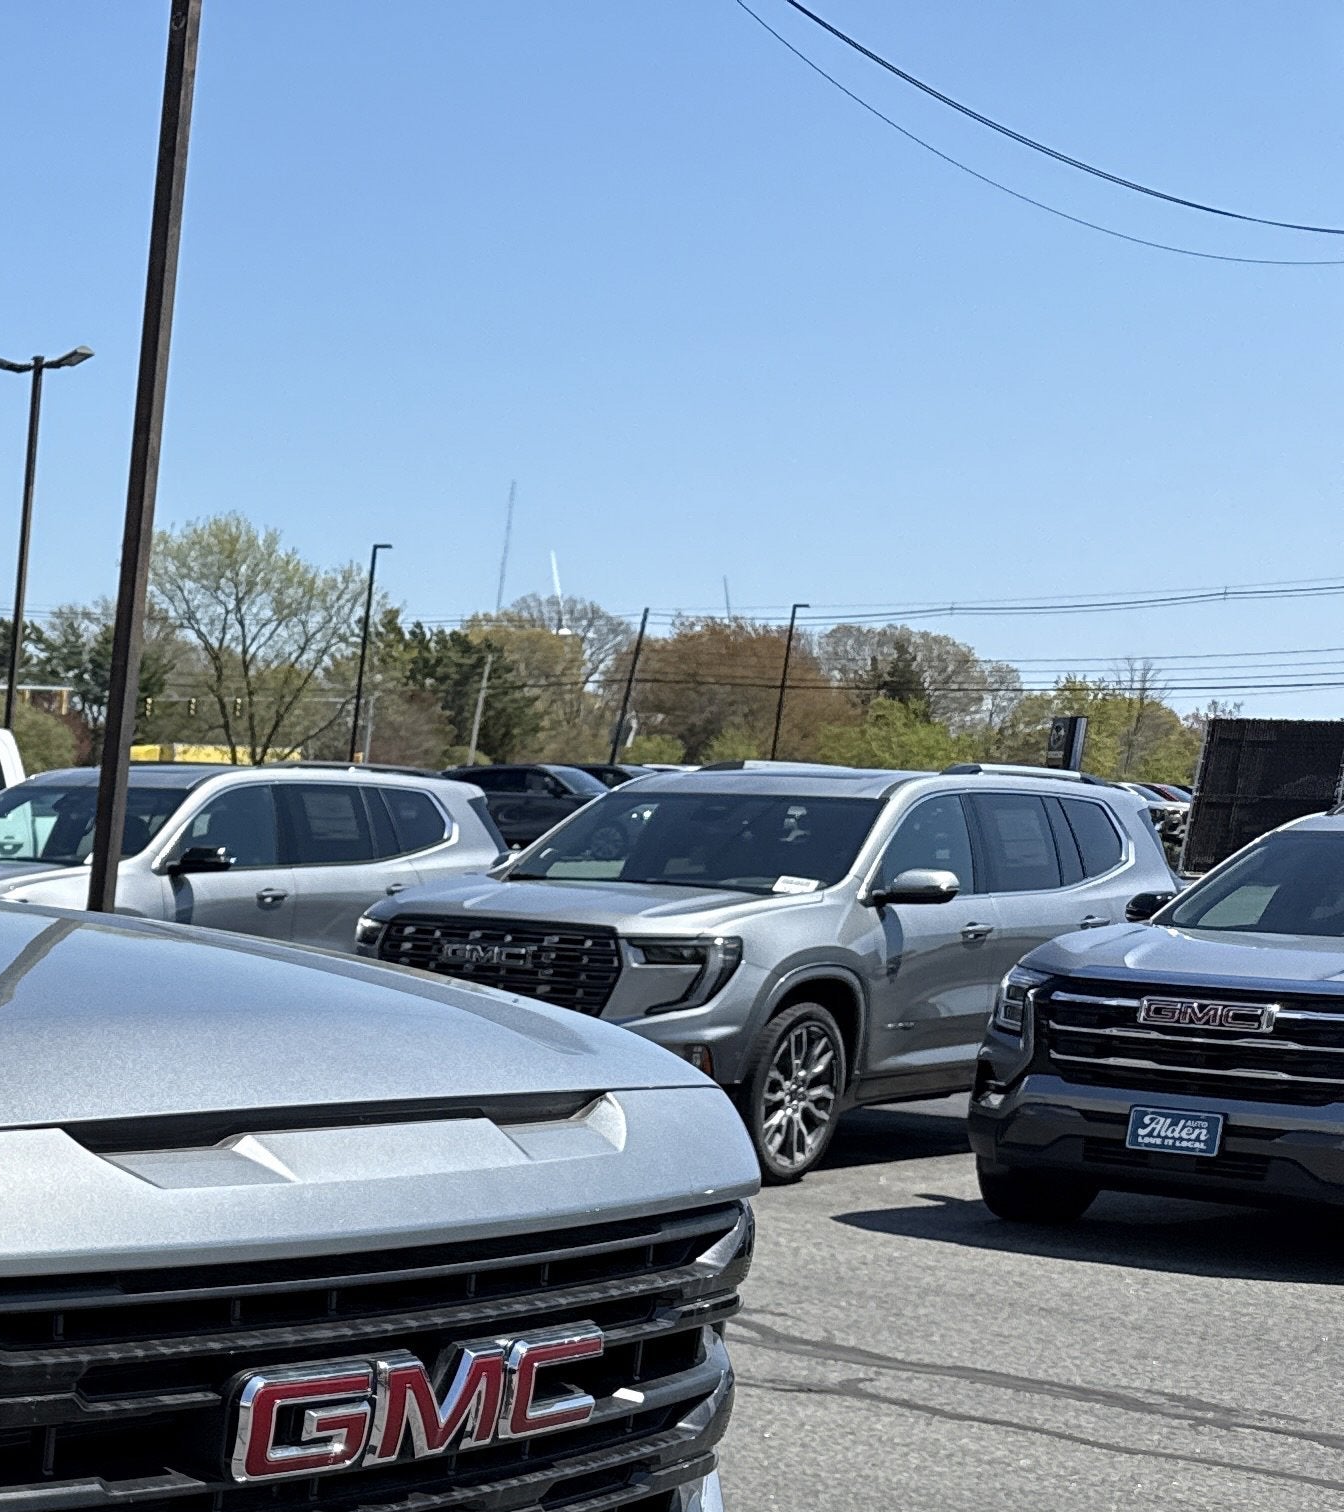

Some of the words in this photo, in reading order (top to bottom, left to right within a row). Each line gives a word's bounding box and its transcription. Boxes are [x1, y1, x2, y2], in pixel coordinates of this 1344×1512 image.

[443, 943, 527, 966] GMC
[1142, 999, 1263, 1030] GMC
[1137, 1114, 1210, 1141] Alden
[1185, 1119, 1209, 1129] AUTO
[1137, 1135, 1162, 1146] LOVE
[1163, 1137, 1174, 1147] IT
[1175, 1139, 1207, 1150] LOCAL
[226, 1319, 605, 1483] GMC
